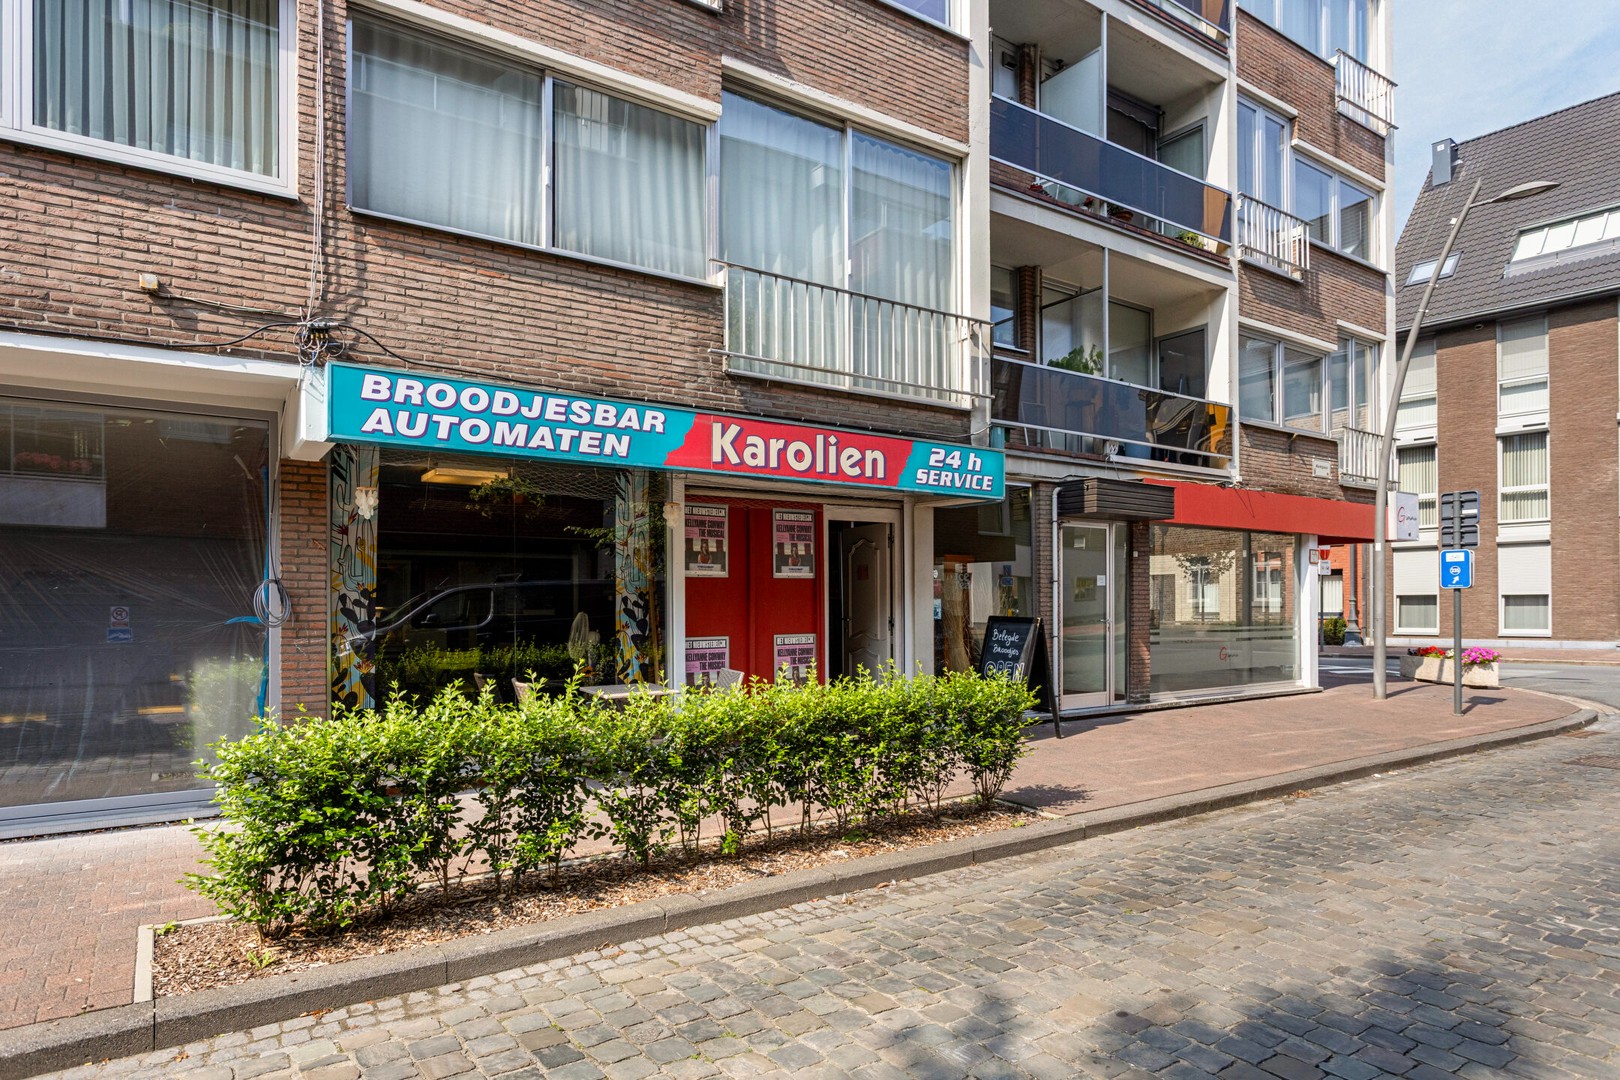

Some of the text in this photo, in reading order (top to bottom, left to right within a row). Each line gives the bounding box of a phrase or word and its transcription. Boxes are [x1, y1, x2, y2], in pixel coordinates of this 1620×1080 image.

[360, 374, 666, 434] BROODJESBAR
[361, 407, 631, 458] AUTOMATEN
[711, 422, 886, 480] Karolien
[929, 448, 982, 473] 24 h
[915, 468, 994, 492] SERVICE
[991, 628, 1020, 646] Belegde
[992, 643, 1019, 659] Broodjes
[699, 662, 707, 670] THE
[984, 660, 1025, 683] OPEN
